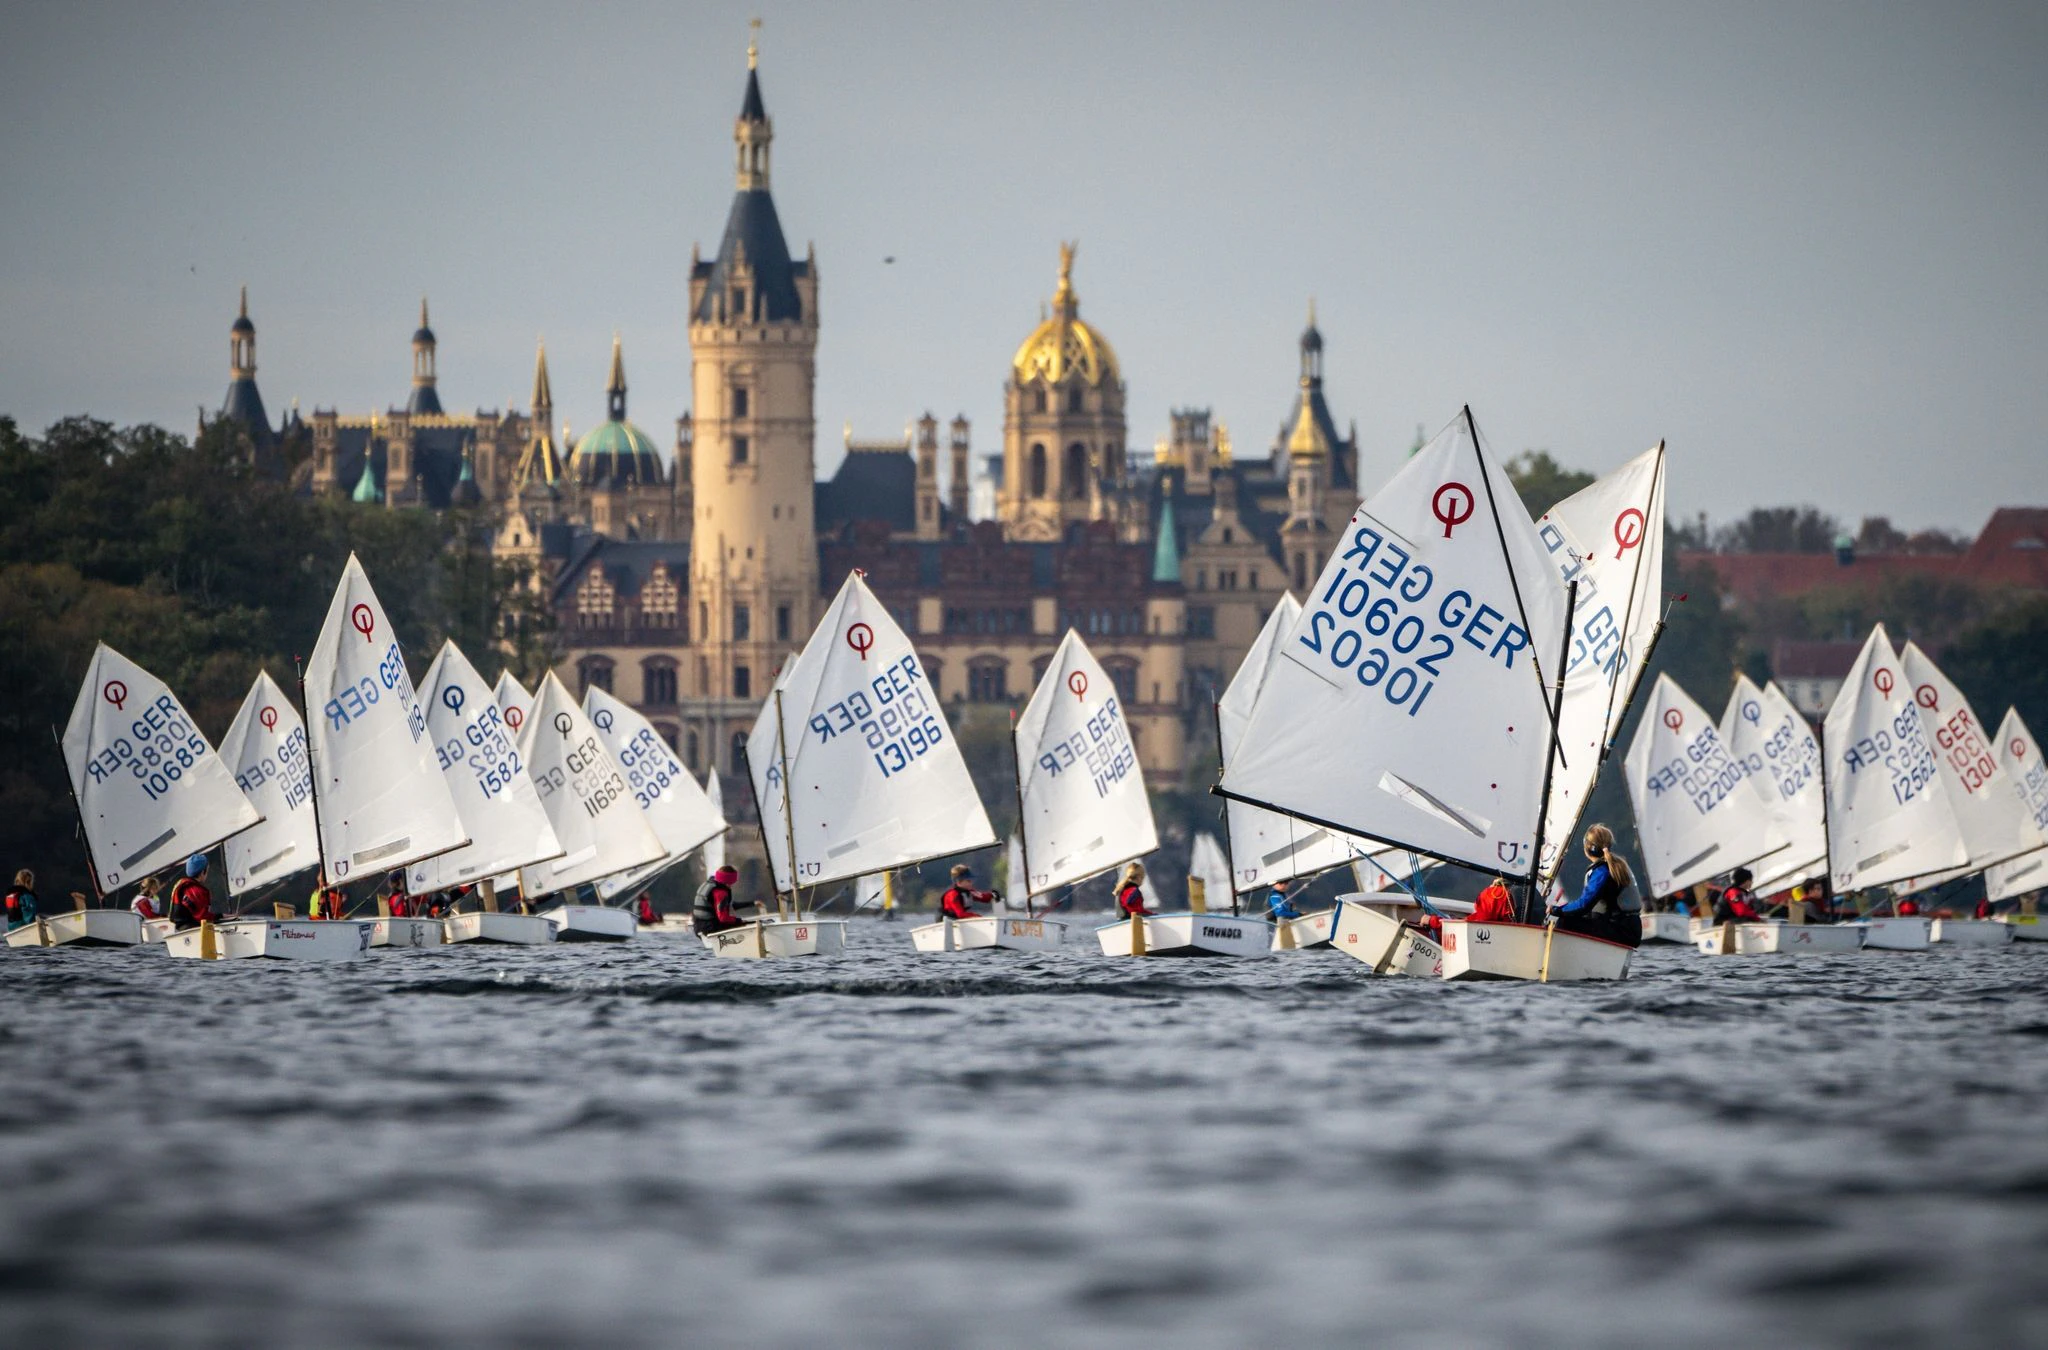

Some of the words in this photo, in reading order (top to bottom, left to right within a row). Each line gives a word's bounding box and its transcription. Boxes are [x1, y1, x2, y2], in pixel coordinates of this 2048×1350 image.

[1323, 567, 1454, 677] 10602
[1438, 590, 1528, 669] GER
[380, 643, 403, 689] GER
[872, 654, 921, 705] GER
[132, 695, 178, 741] GER
[466, 704, 502, 746] GER
[1087, 697, 1119, 743] GER
[1893, 700, 1918, 740] GER
[1936, 708, 1974, 749] GER
[141, 733, 206, 801] 10685
[277, 726, 305, 763] GER
[566, 736, 600, 774] GER
[620, 728, 655, 767] GER
[875, 715, 942, 778] 13196
[1687, 726, 1718, 763] GER
[479, 751, 523, 800] 1582
[1094, 744, 1134, 799] 11483
[1693, 762, 1742, 815] 12200
[1892, 751, 1937, 806] 12562
[1960, 751, 1998, 794] 1301
[584, 772, 625, 818] 11663
[1203, 926, 1242, 939] THUNDER
[1410, 938, 1438, 960] 10603
